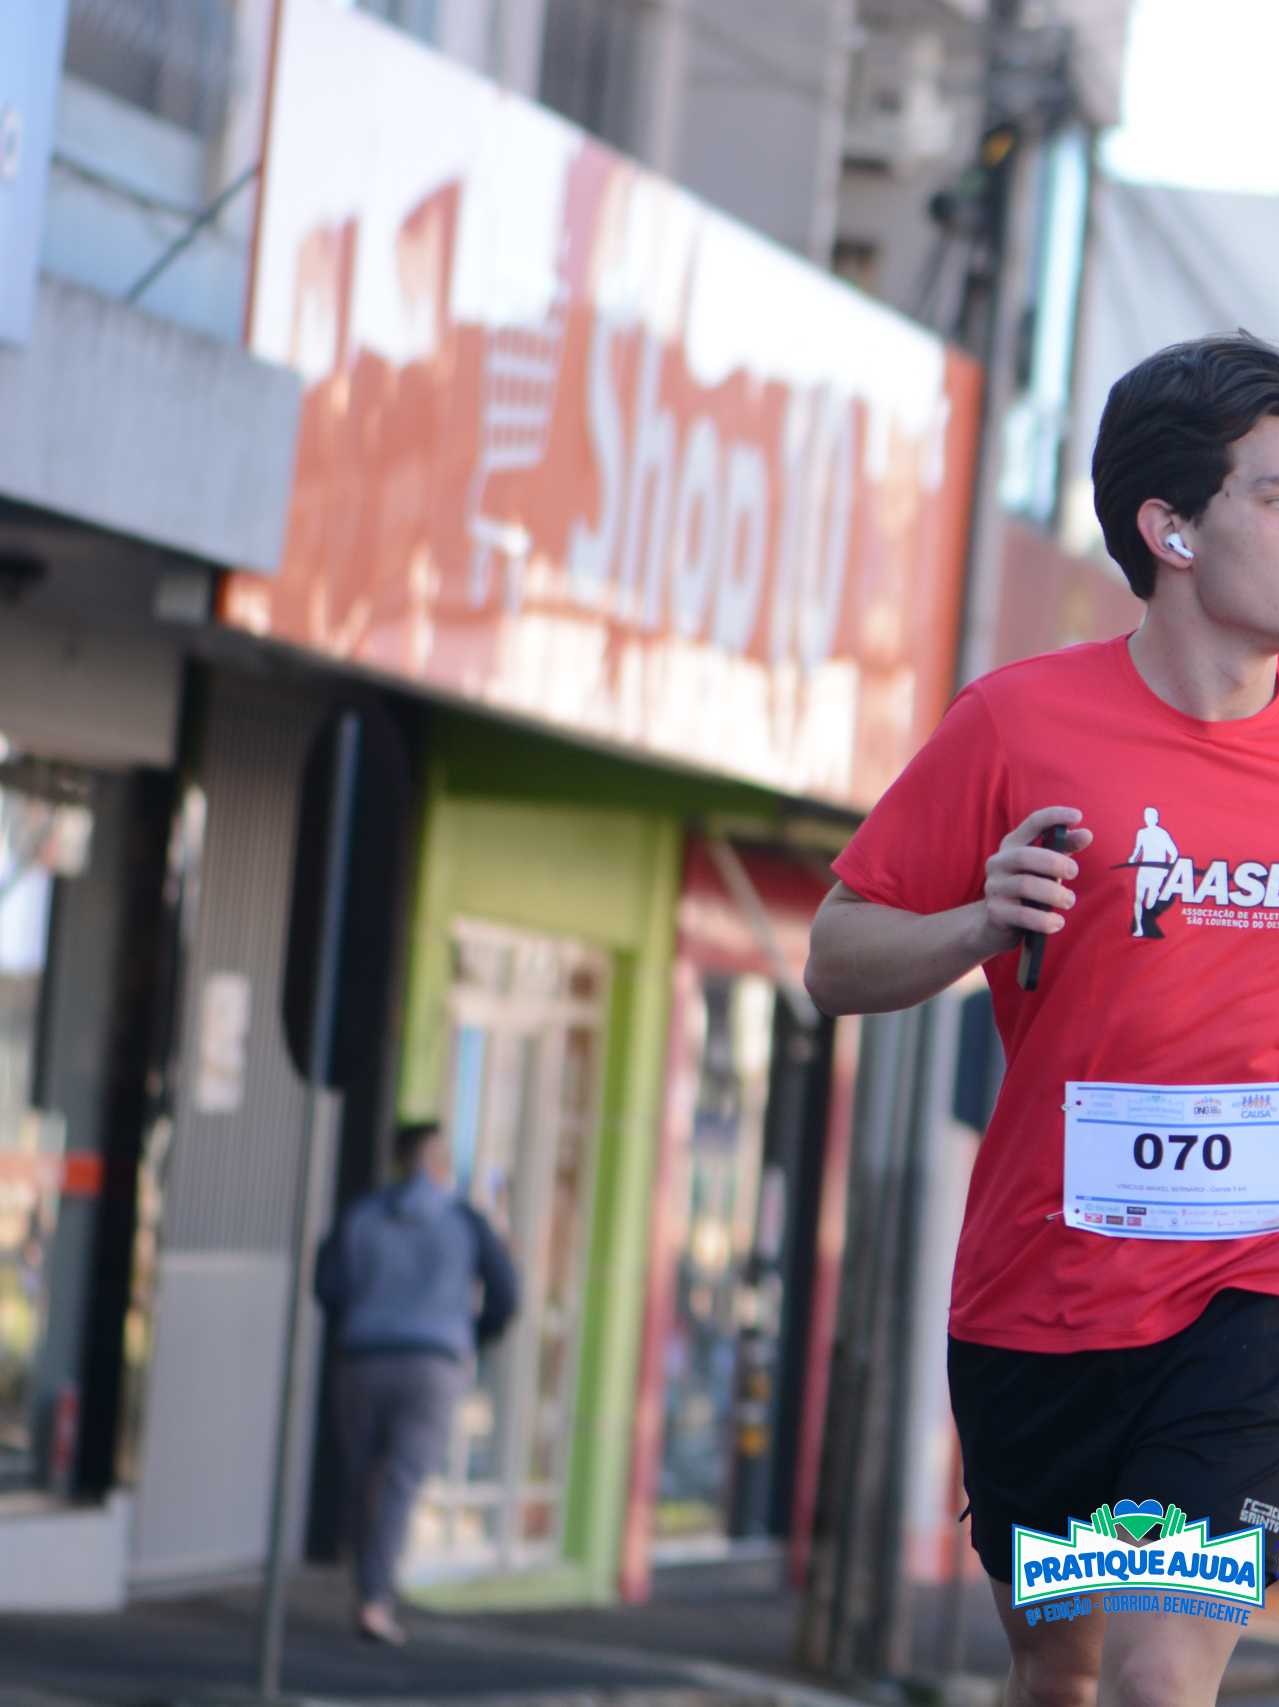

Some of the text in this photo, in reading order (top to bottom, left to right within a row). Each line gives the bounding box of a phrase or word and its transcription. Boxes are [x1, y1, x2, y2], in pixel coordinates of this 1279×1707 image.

[1181, 907, 1235, 919] ASSOCIAÇÃO
[1237, 911, 1249, 920] DE
[1186, 916, 1203, 925] SÃO
[1205, 918, 1250, 929] LOURENÇO
[1252, 920, 1264, 929] DO
[1193, 1106, 1210, 1115] ONG
[1241, 1110, 1272, 1119] CAUSA
[1133, 1133, 1232, 1171] 070
[1116, 1183, 1145, 1191] VINICIUS
